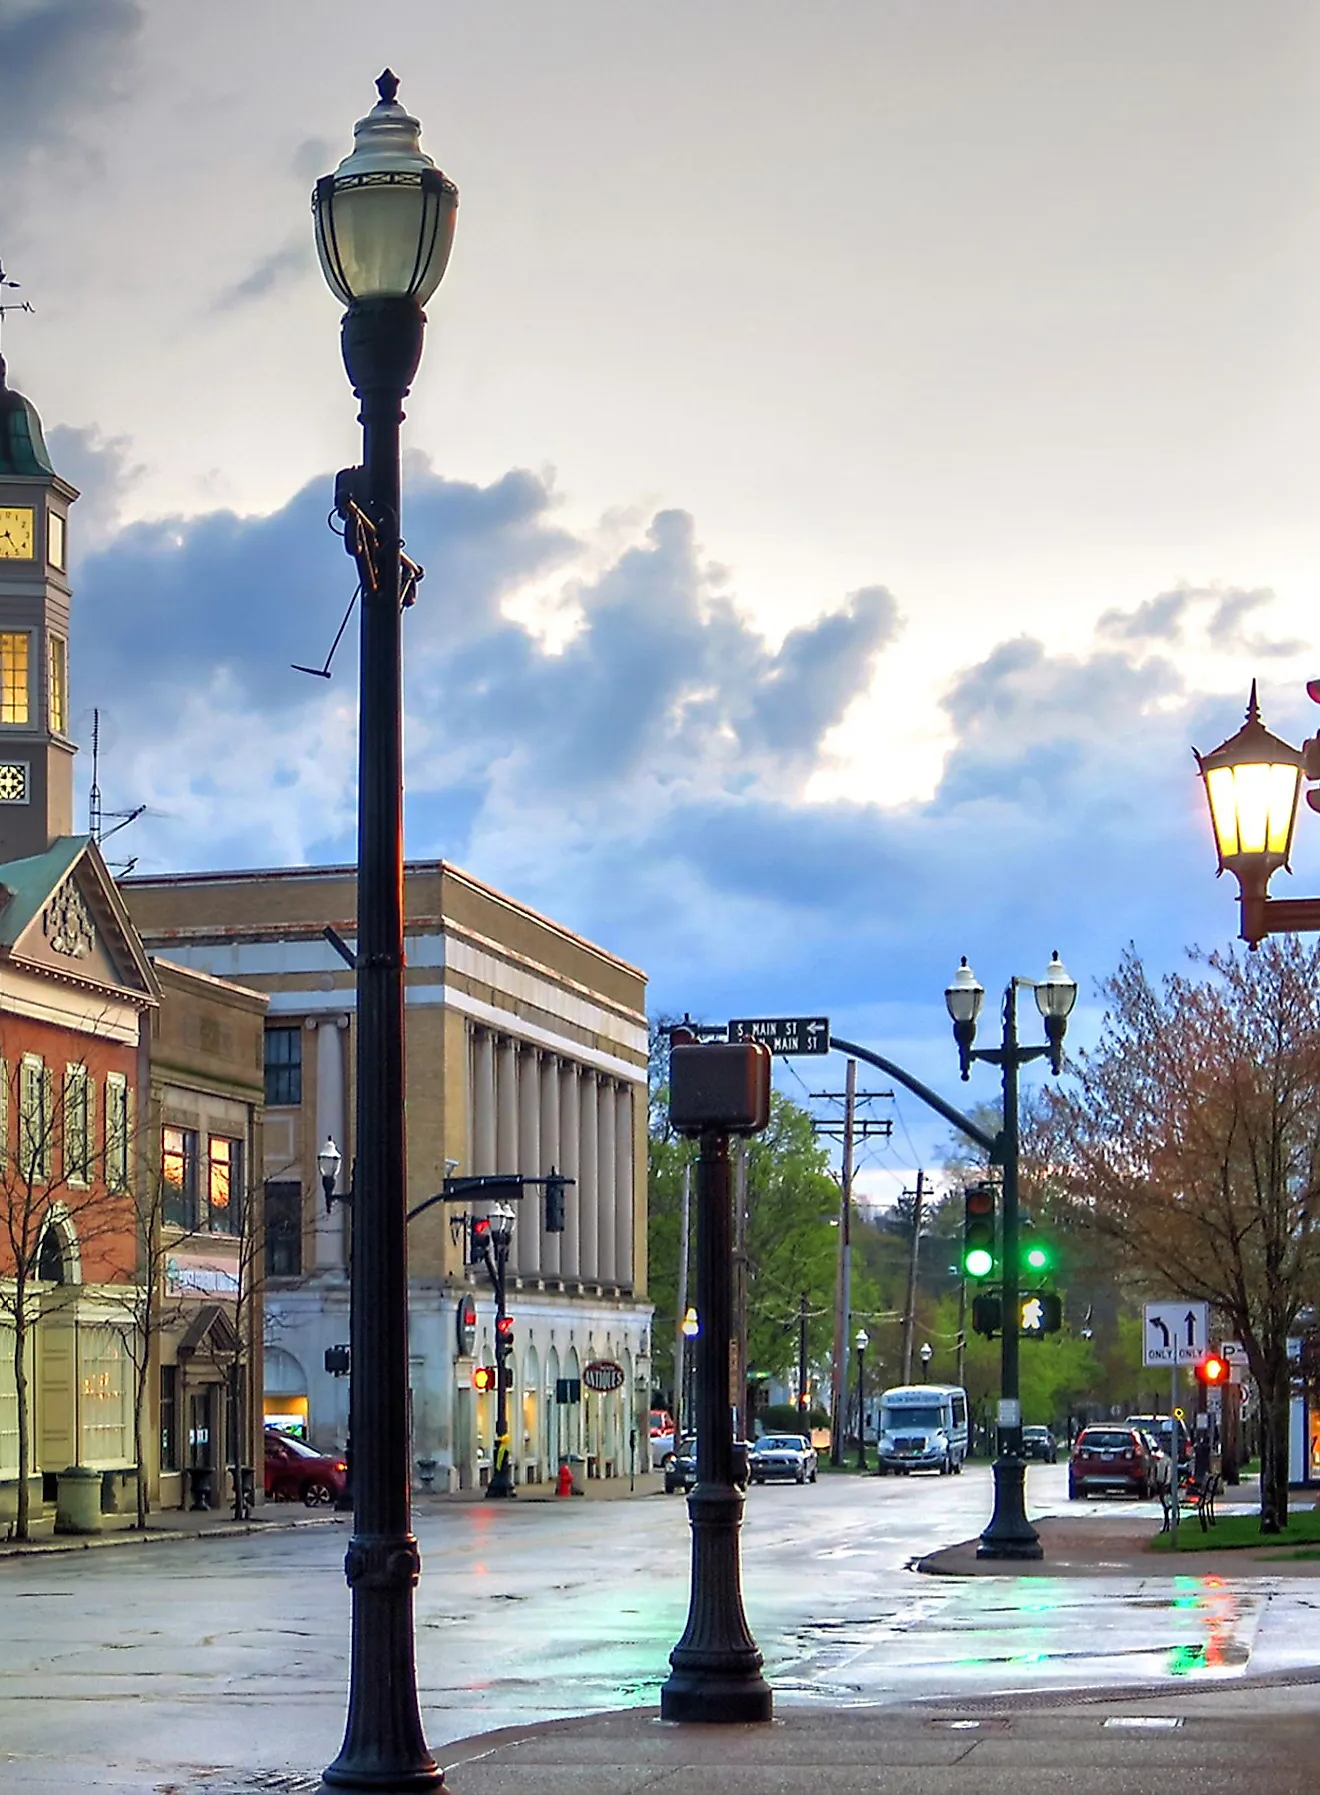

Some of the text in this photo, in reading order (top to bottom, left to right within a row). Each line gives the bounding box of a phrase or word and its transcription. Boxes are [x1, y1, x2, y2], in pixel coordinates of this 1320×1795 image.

[737, 1022, 798, 1036] S MAIN ST
[773, 1036, 799, 1050] MAIN
[807, 1037, 819, 1050] ST
[1148, 1350, 1172, 1360] ONLY
[1179, 1349, 1204, 1359] ONLY
